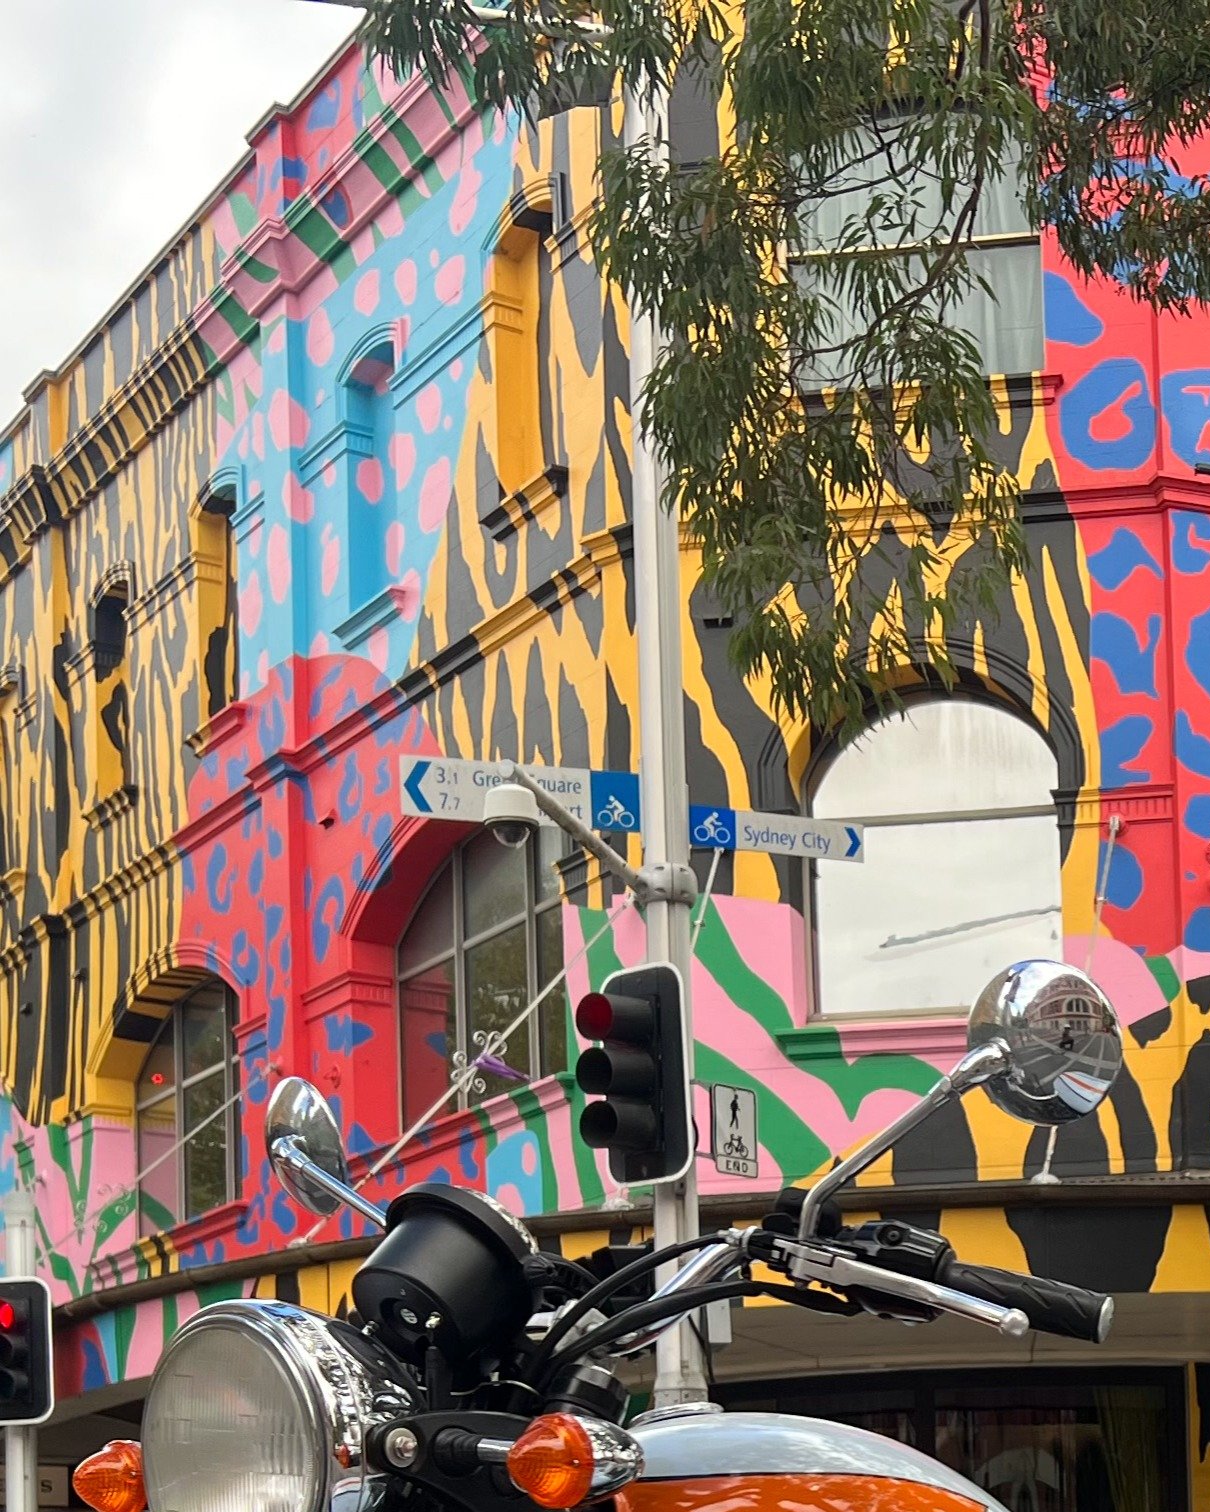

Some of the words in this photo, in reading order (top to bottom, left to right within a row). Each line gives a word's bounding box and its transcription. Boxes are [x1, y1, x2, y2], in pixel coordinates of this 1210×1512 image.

[436, 766, 458, 784] 3.1
[530, 773, 582, 795] quare
[439, 792, 461, 811] 7.7
[744, 825, 797, 850] Sydney
[801, 831, 831, 854] City
[725, 1159, 749, 1173] END
